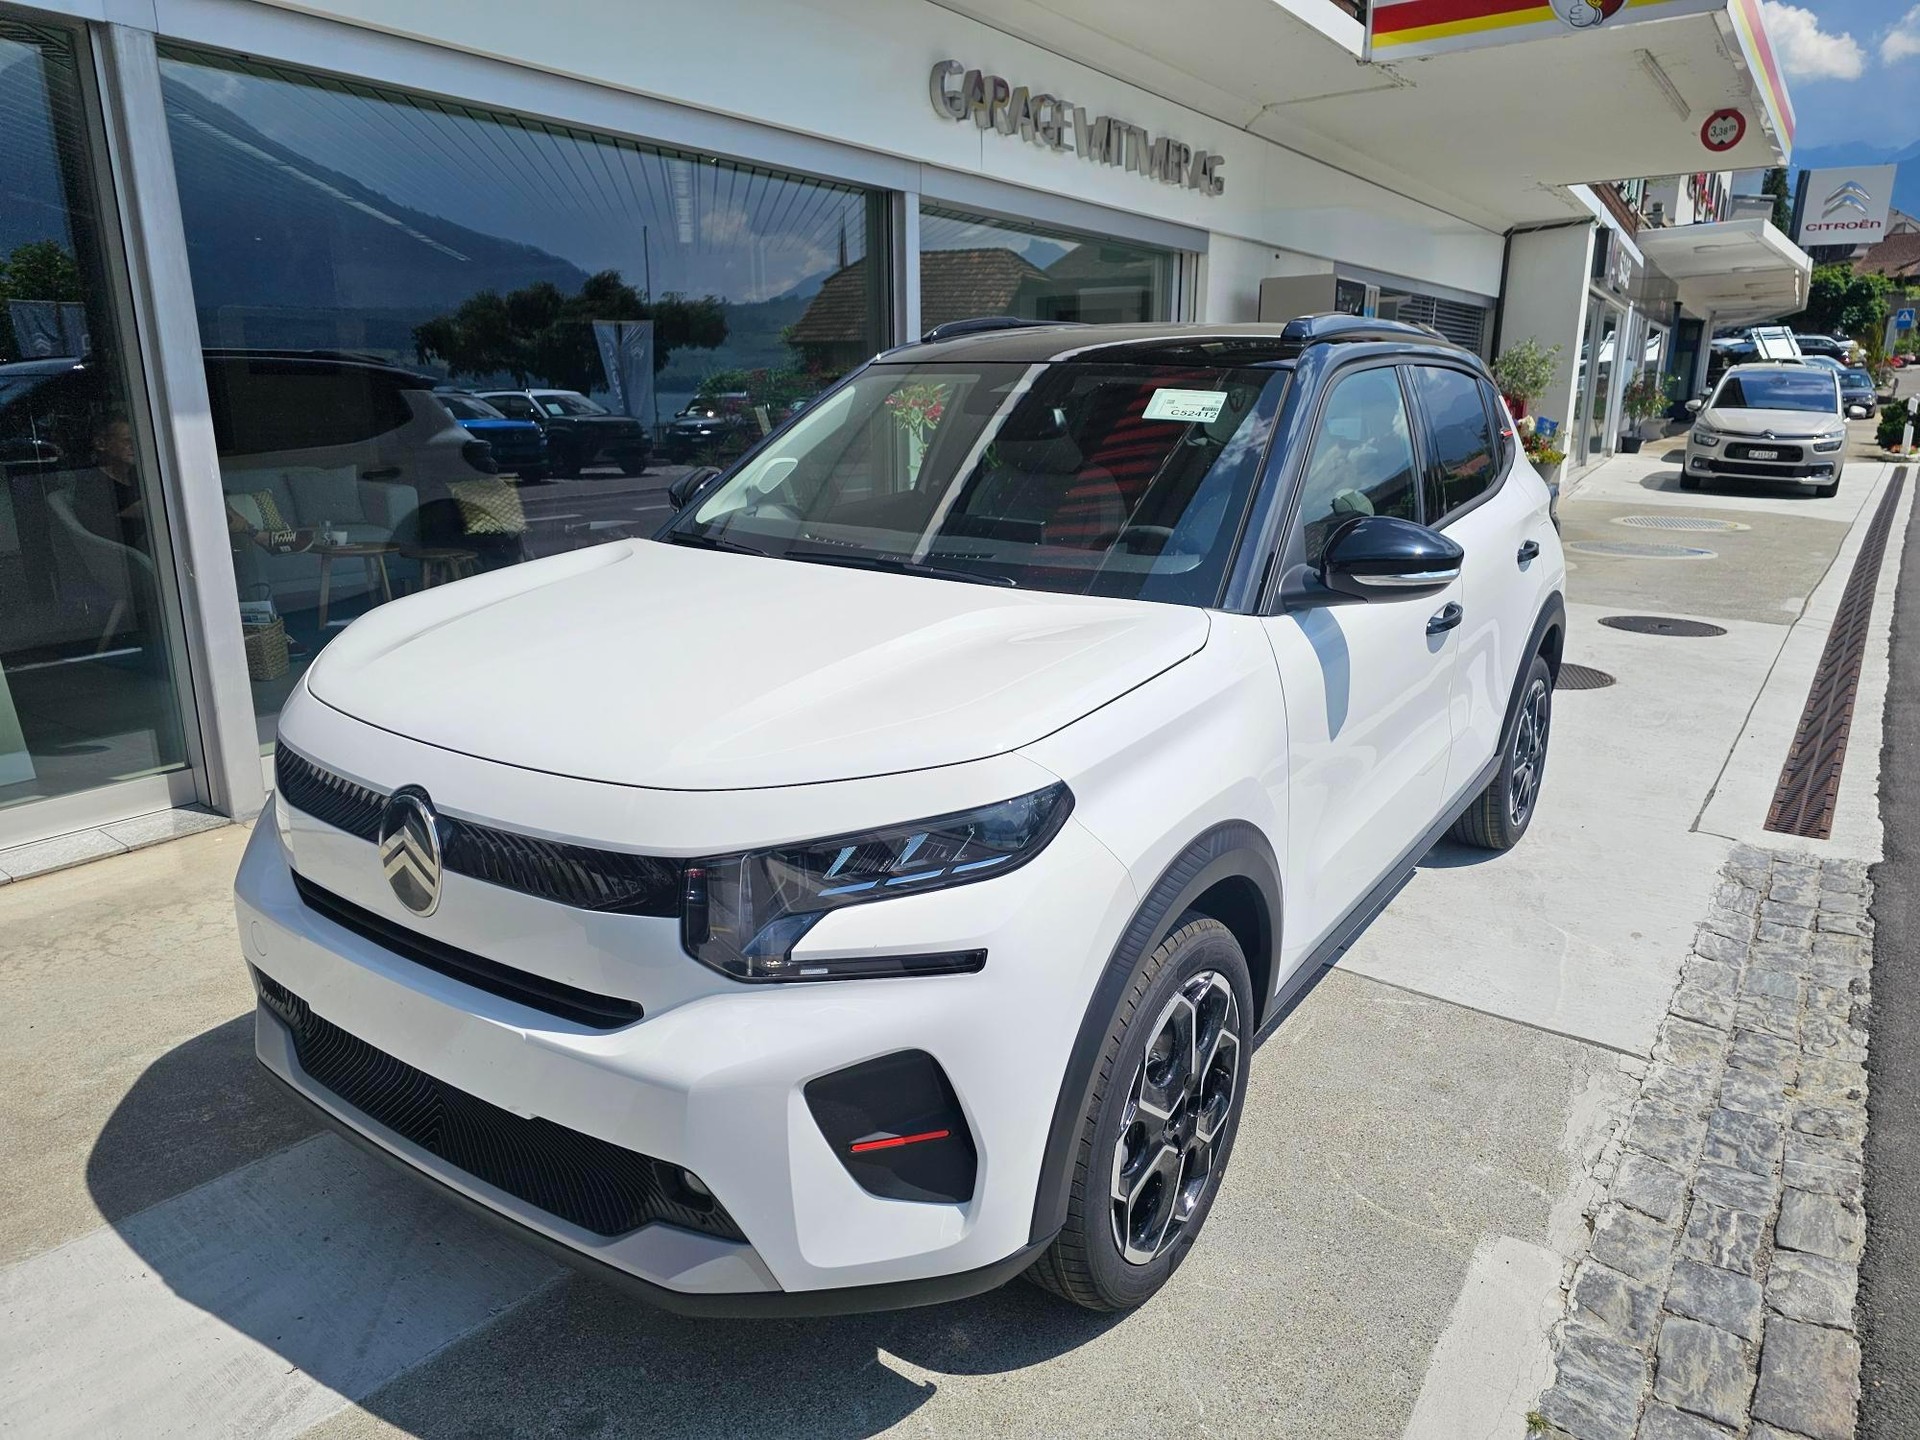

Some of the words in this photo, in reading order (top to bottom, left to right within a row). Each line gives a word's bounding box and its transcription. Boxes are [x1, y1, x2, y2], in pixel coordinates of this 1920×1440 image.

[929, 59, 1074, 152] GARAGE
[1188, 150, 1225, 197] AG
[1170, 410, 1217, 419] C52412
